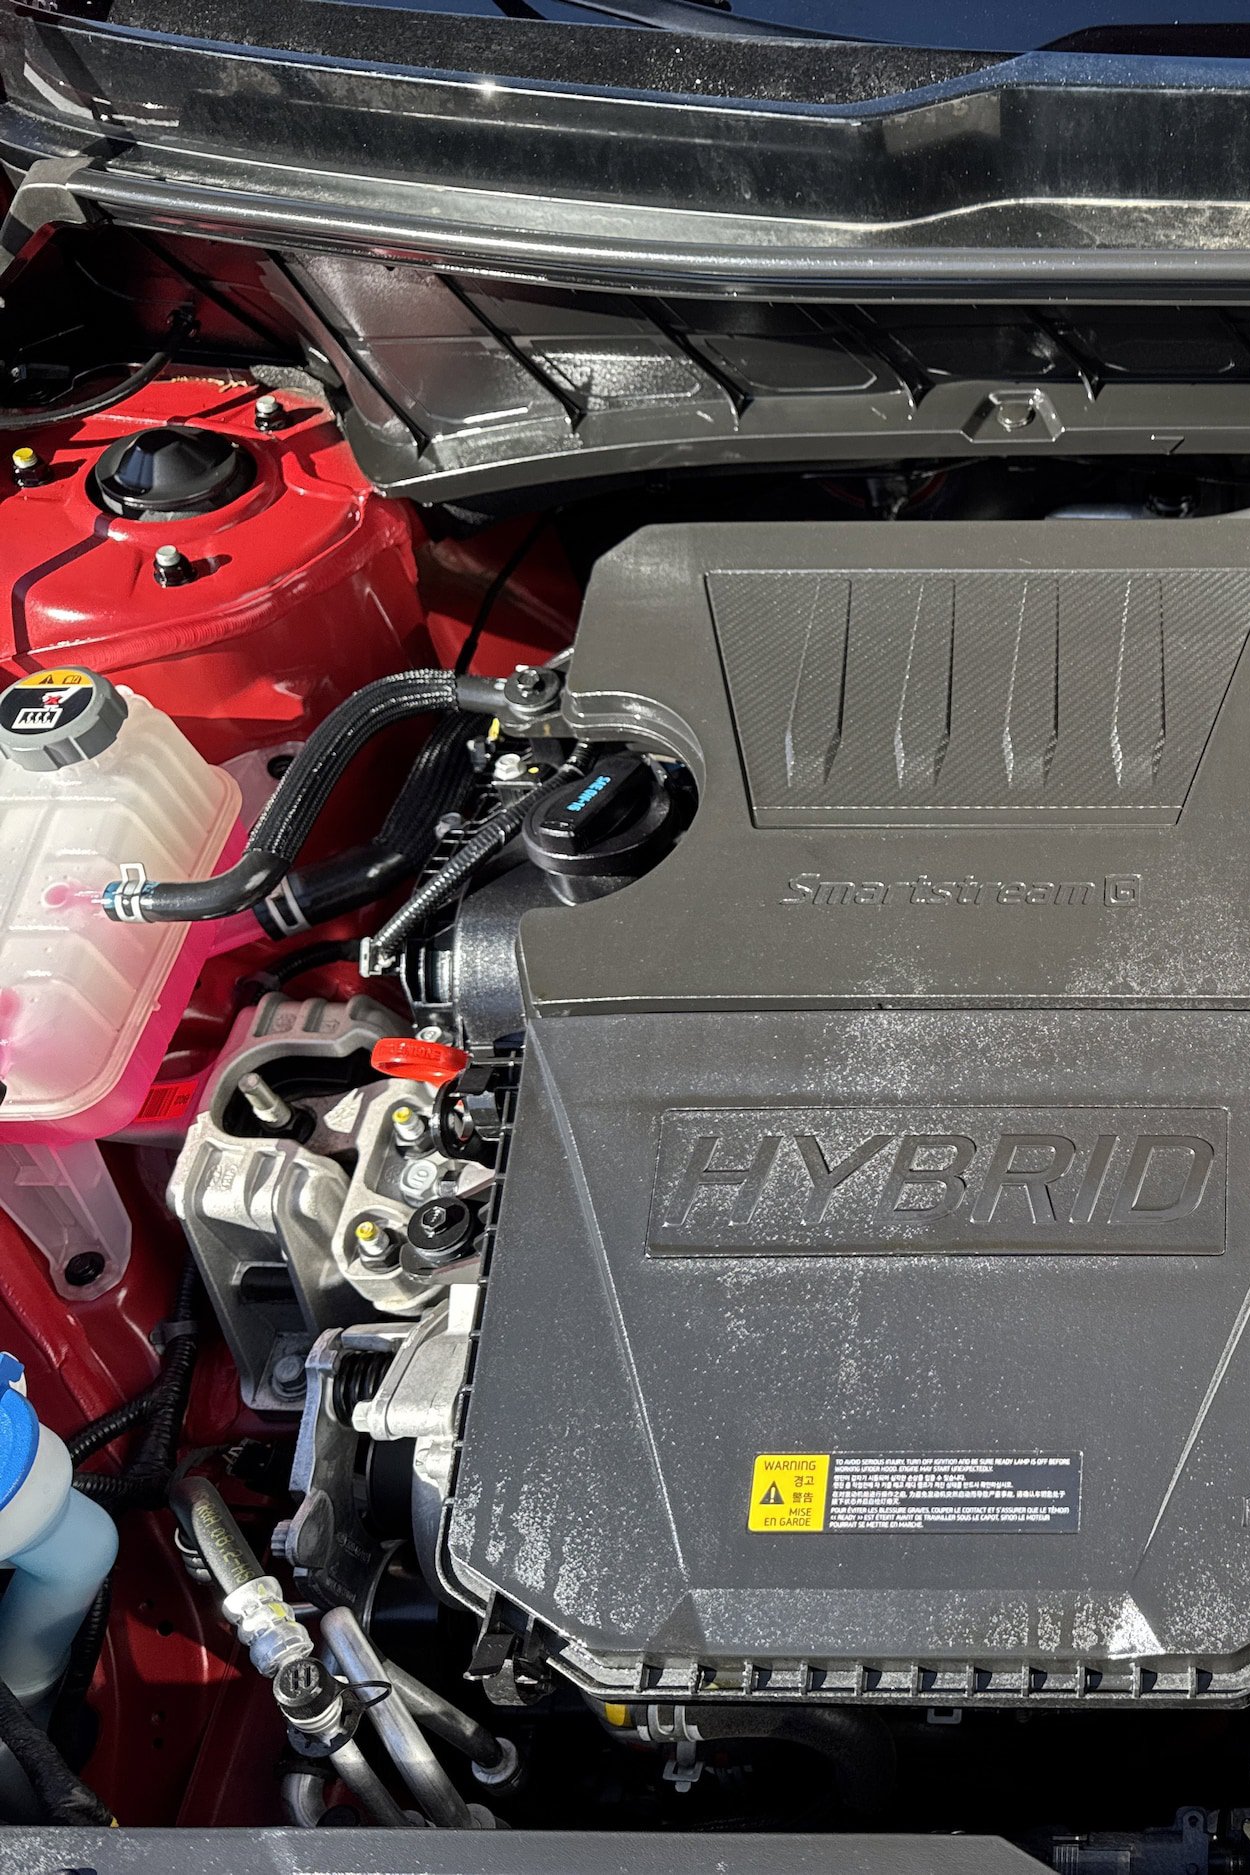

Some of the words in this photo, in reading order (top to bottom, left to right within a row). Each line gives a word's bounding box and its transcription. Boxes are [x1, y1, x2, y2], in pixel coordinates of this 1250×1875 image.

[778, 872, 1096, 906] Smartstream
[663, 1134, 1215, 1226] HYBRID
[764, 1460, 816, 1471] WARNING
[794, 1475, 814, 1487] 경고
[792, 1492, 813, 1503] 警告
[789, 1508, 812, 1516] MISE
[764, 1517, 776, 1526] EN
[780, 1517, 811, 1526] GARDE
